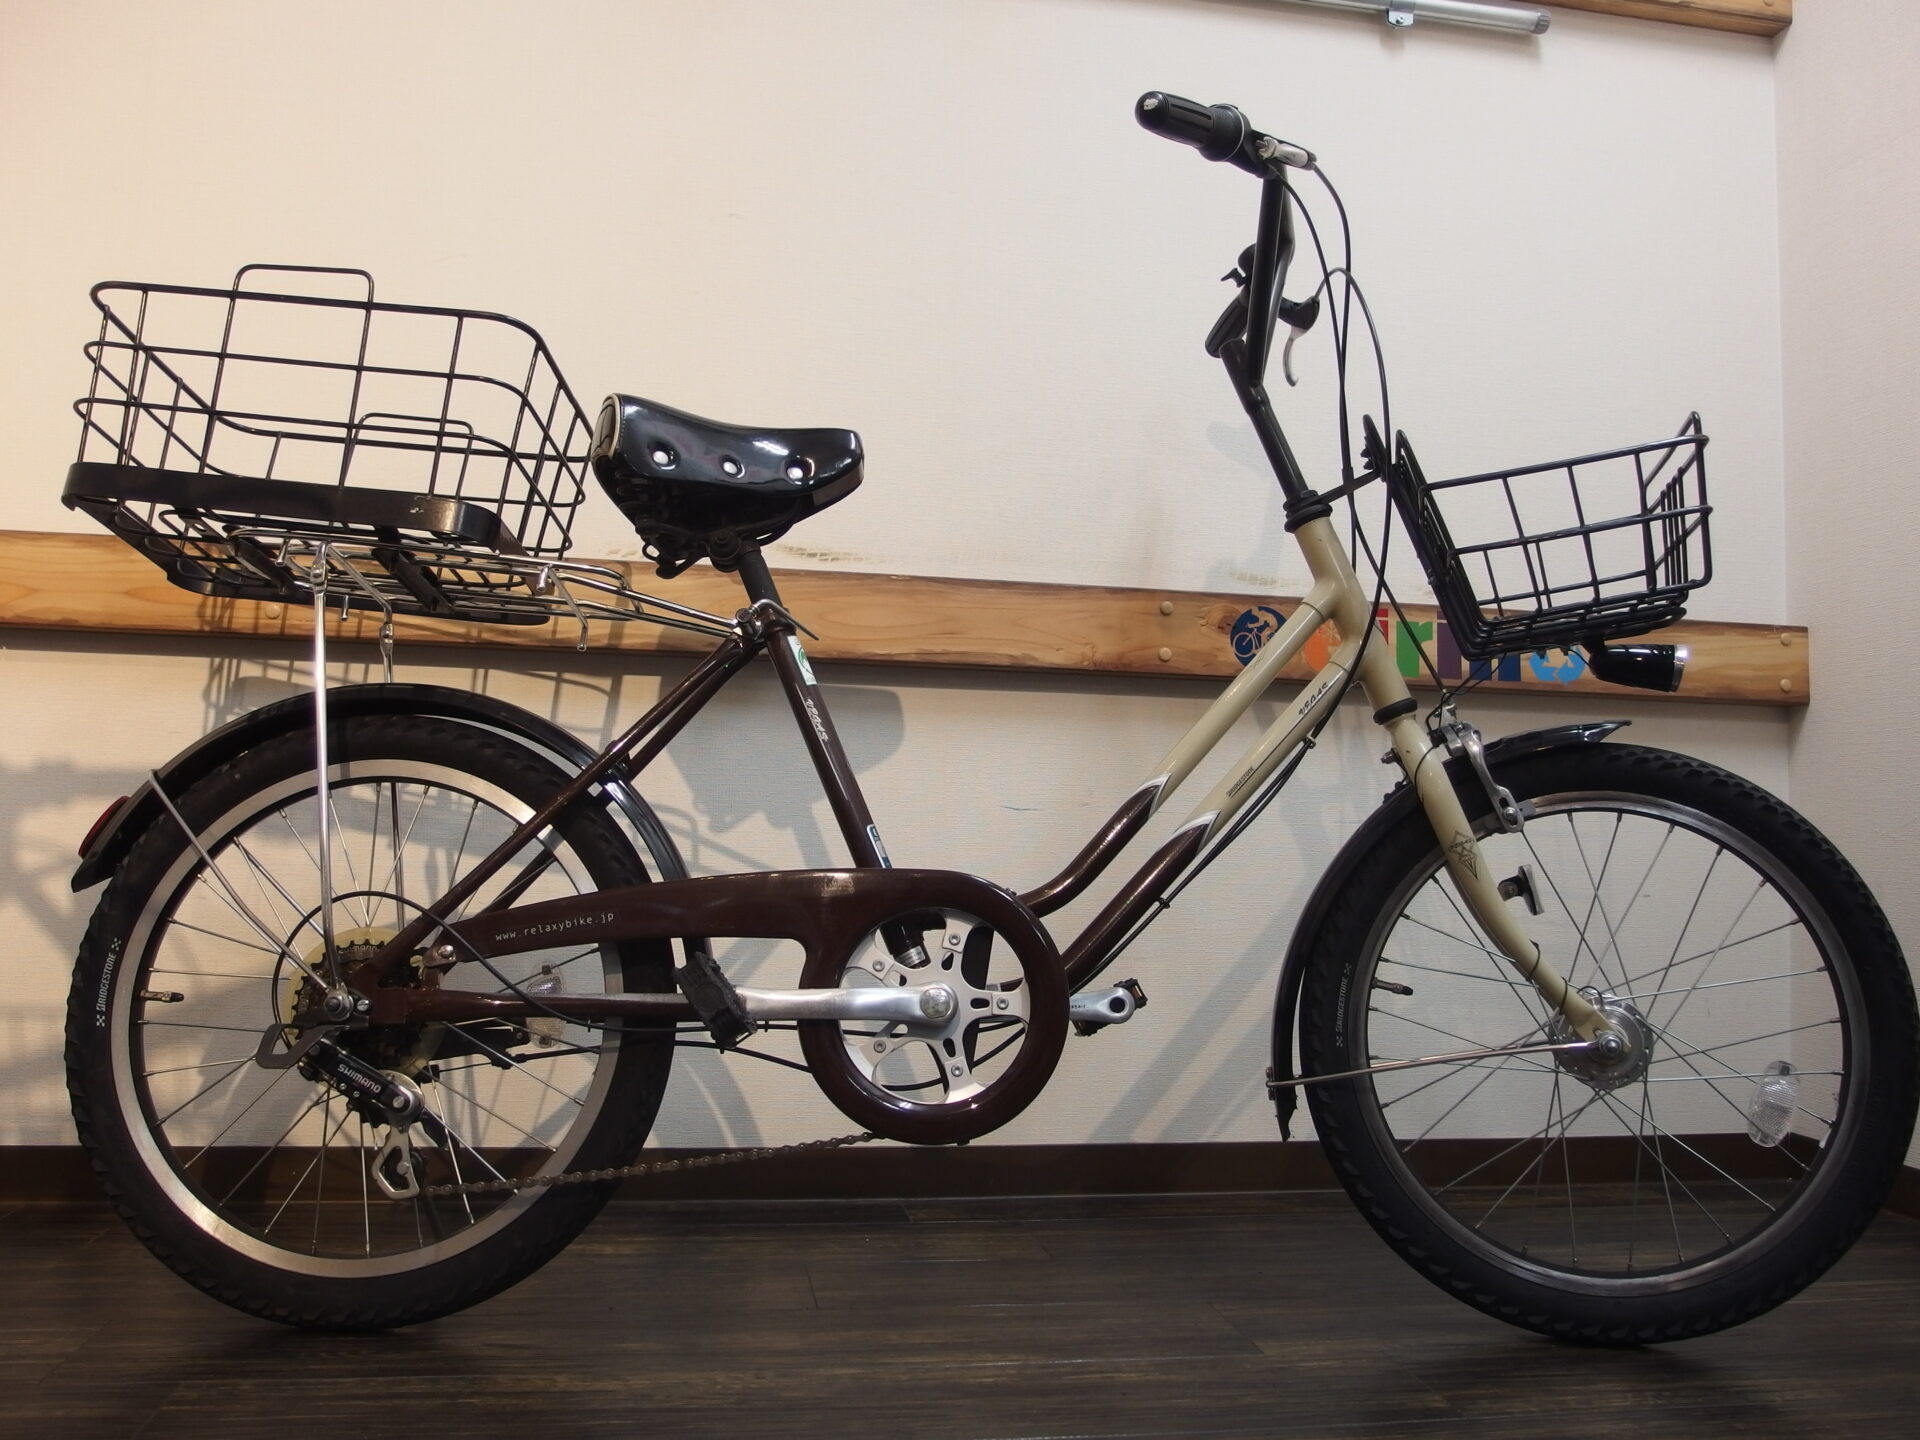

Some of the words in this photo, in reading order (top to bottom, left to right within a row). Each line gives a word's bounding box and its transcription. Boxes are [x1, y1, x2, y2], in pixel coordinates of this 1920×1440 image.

[495, 912, 614, 941] www.relaxybike.jp
[96, 952, 117, 1012] BRIDGESTONE
[337, 1063, 382, 1094] SHIMANO
